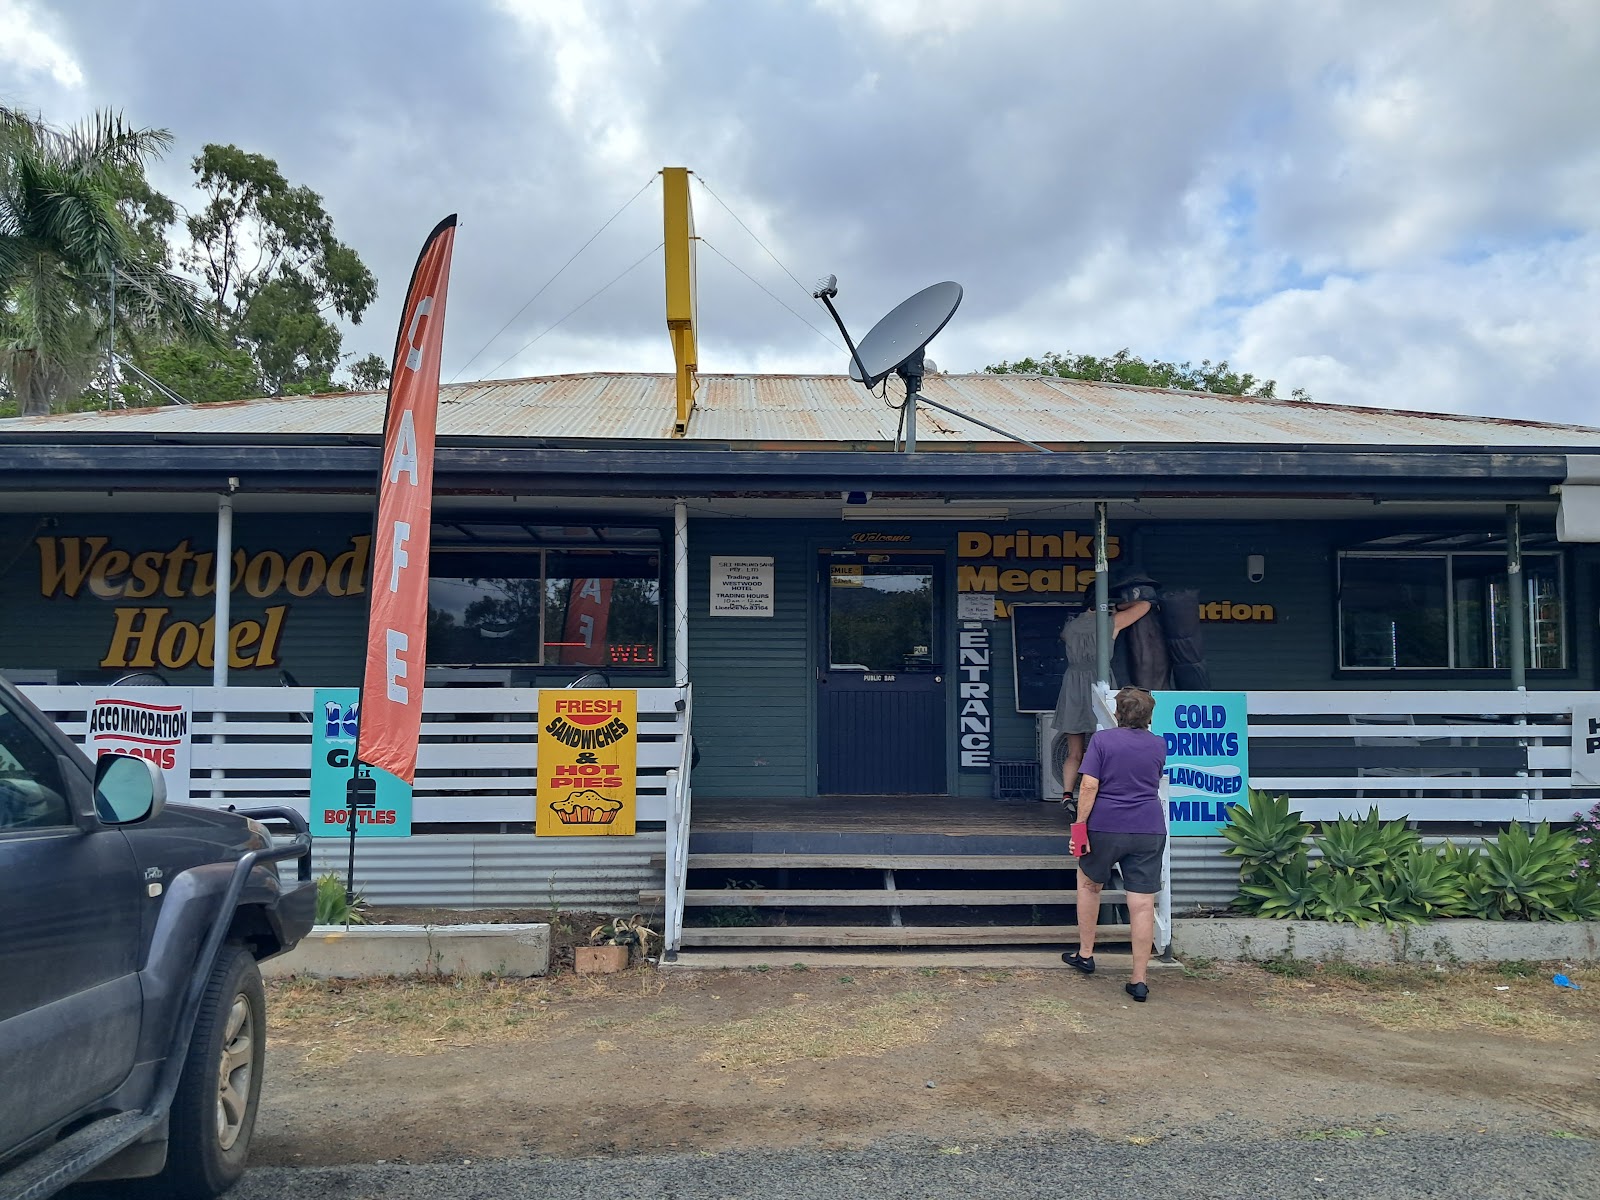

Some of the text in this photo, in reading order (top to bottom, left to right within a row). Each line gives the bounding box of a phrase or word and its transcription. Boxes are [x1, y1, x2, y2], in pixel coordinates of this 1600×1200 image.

[386, 296, 433, 705] CAFE
[851, 532, 912, 542] Welcome
[957, 530, 1121, 558] Drinks
[36, 535, 373, 599] Westwood
[957, 565, 1096, 592] Meals
[101, 605, 286, 669] Hotel
[555, 700, 622, 713] FRESH
[959, 631, 991, 767] ENTRANCE
[90, 707, 187, 738] ACCOMMODATION
[324, 701, 359, 738] IC
[1174, 704, 1227, 729] COLD
[545, 716, 629, 750] SANDWICHES
[1163, 732, 1239, 756] DRINKS
[555, 765, 620, 776] HOT
[576, 752, 600, 764] &
[551, 777, 623, 788] PIES
[1169, 802, 1237, 821] MILK
